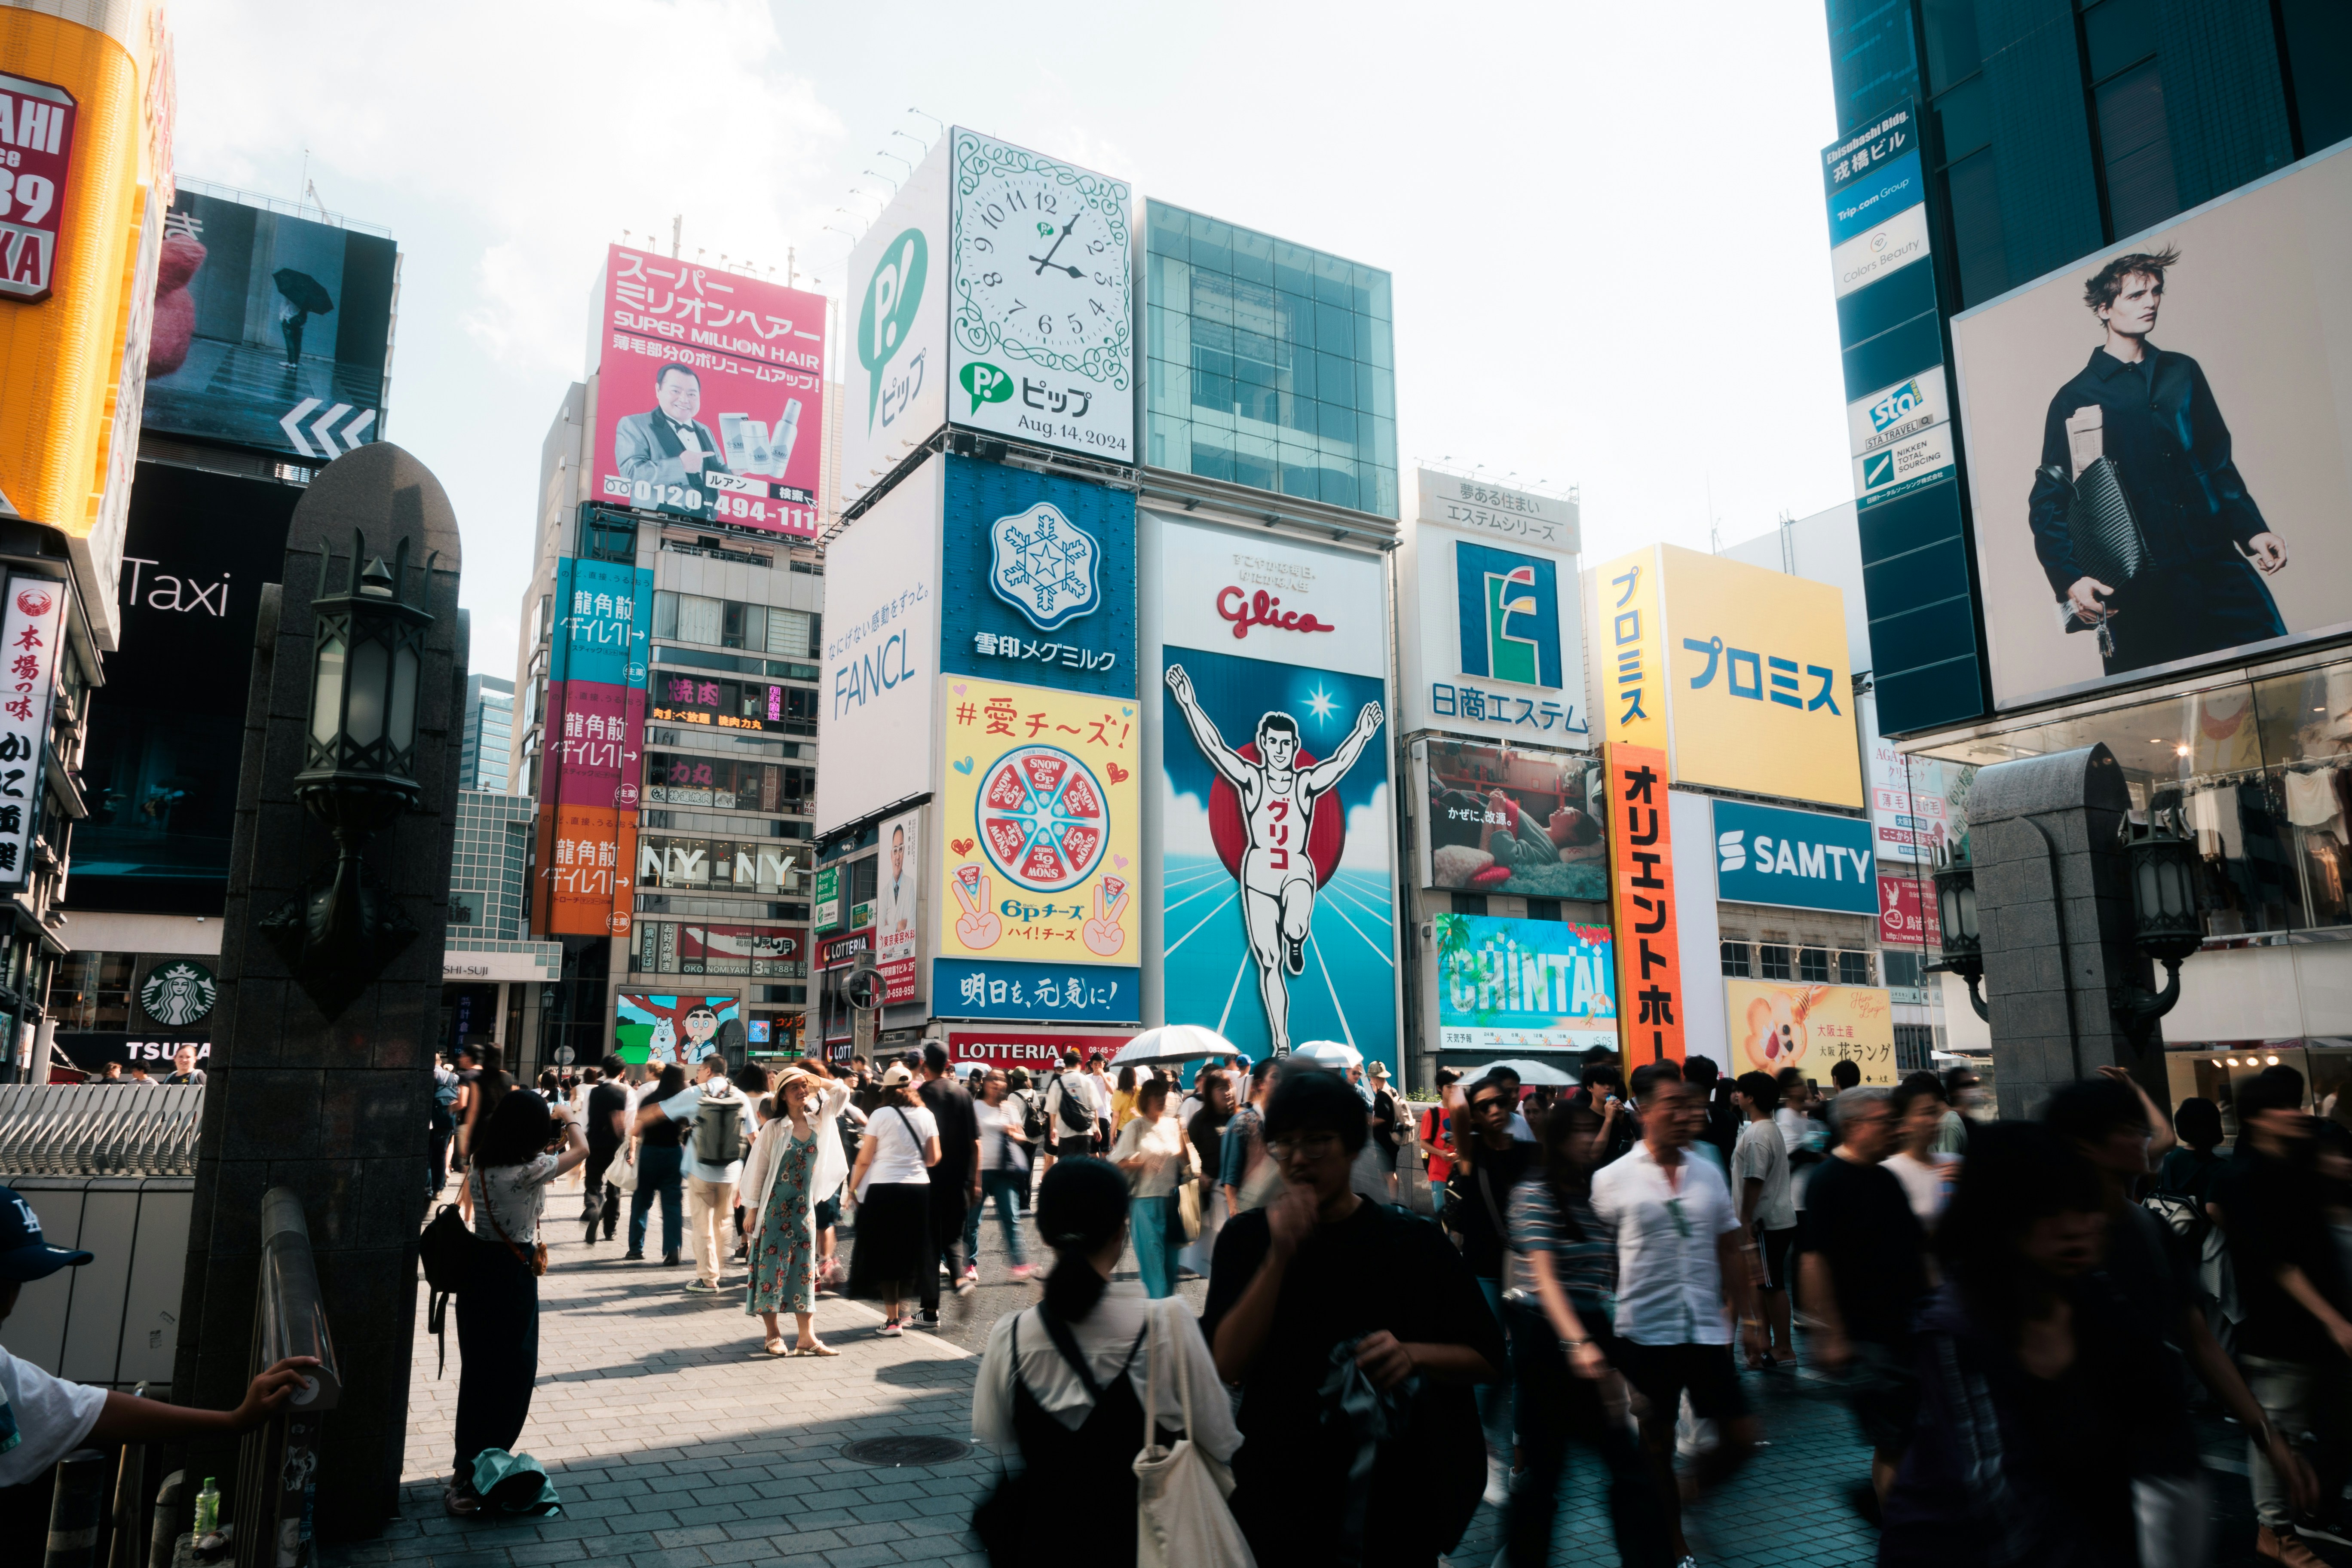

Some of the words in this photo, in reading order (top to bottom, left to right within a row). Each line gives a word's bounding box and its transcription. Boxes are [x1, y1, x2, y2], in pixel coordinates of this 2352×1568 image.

[1827, 124, 1881, 165] Ebisubashi
[1882, 110, 1909, 132] Bldg.
[1833, 131, 1905, 183] 戎橋ビル
[1006, 190, 1028, 212] 11
[1035, 191, 1057, 215] 12
[1838, 194, 1879, 221] Trip.com
[1880, 178, 1909, 199] Group
[981, 203, 1005, 230] 10
[974, 237, 994, 254] 9
[1085, 239, 1104, 256] 2
[617, 252, 734, 296] スーパー
[1844, 261, 1877, 283] Colors
[1880, 239, 1919, 266] Beauty
[983, 272, 1003, 287] 8
[1094, 272, 1113, 288] 3
[616, 280, 820, 341] ミリオンヘアー
[1008, 298, 1027, 315] 7
[1088, 298, 1106, 316] 4
[1038, 314, 1053, 334] 6
[1067, 312, 1083, 334] 5
[614, 311, 683, 339] SUPER
[691, 328, 765, 358] MILLION
[771, 346, 819, 369] HAIR
[882, 347, 927, 428] ピップ
[1023, 377, 1092, 417] ピップ
[1909, 379, 1922, 404] TRAVEL
[1875, 392, 1915, 427] sta
[1018, 414, 1057, 438] Aug.
[1060, 424, 1082, 444] 14,
[1086, 429, 1127, 451] 2024
[1868, 435, 1883, 448] STA
[1885, 423, 1916, 442] TRAVEL
[774, 450, 787, 458] SMH
[1897, 441, 1927, 457] NIKKEN
[1898, 451, 1923, 465] TOTAL
[1899, 452, 1941, 473] SOURCING
[710, 474, 747, 490] ルアン
[779, 487, 803, 502] 検索
[1460, 483, 1540, 514] 夢ある住まい
[1867, 471, 1943, 504] 日研トータルソーシング株式会社
[634, 481, 815, 530] 0120-494-111
[1447, 505, 1555, 542] エステムシリーズ
[122, 556, 230, 617] Taxi
[574, 590, 636, 621] 龍角散
[1217, 585, 1335, 639] Glico
[829, 581, 928, 661] なにげない感動をずっと。
[572, 645, 603, 653] スティック
[974, 632, 1115, 671] 雪印メグミルク
[1612, 566, 1648, 726] プロミス
[6, 624, 43, 722] 本場の味
[834, 628, 915, 721] FANCL
[1683, 636, 1842, 716] プロミス
[669, 679, 719, 707] 焼肉
[1433, 683, 1588, 734] 日商エステム
[566, 712, 628, 741] 龍角散
[1030, 758, 1060, 770] SNOW
[1876, 748, 1898, 762] AGA
[670, 761, 713, 785] 力丸
[991, 770, 1012, 802] SNOW
[669, 790, 712, 804] 特選焼肉
[1013, 790, 1026, 809] CHEESE
[1063, 795, 1075, 815] CHEESE
[1076, 780, 1097, 811] SNOW
[1448, 807, 1512, 827] かぜに、改源。
[989, 825, 1011, 858] SNOW
[1012, 822, 1025, 842] CHEESE
[1063, 827, 1075, 846] CHEESE
[1267, 798, 1289, 870] グリコ
[556, 839, 620, 867] 龍角散
[1076, 834, 1096, 865] SNOW
[1754, 836, 1870, 883] SAMTY
[641, 846, 705, 879] NY
[736, 852, 796, 885] NY
[1028, 867, 1059, 878] SNOW
[1107, 878, 1122, 887] SNOW
[1624, 765, 1673, 1061] オリエントホー
[643, 928, 655, 967] 焼きそば
[662, 924, 674, 971] お好み焼き
[753, 934, 793, 955] 風月
[832, 937, 866, 959] LOTTERIA
[884, 928, 915, 947] 東京美容外科
[909, 962, 915, 971] 2F
[1449, 934, 1607, 1014] CHINTAI
[1447, 1033, 1472, 1043] 天気予報
[1817, 1024, 1854, 1038] 大阪土産
[126, 1042, 211, 1060] TSUA
[959, 1043, 1060, 1059] LOTTERIA
[1819, 1046, 1835, 1057] 大阪
[1838, 1042, 1890, 1063] 花ラング
